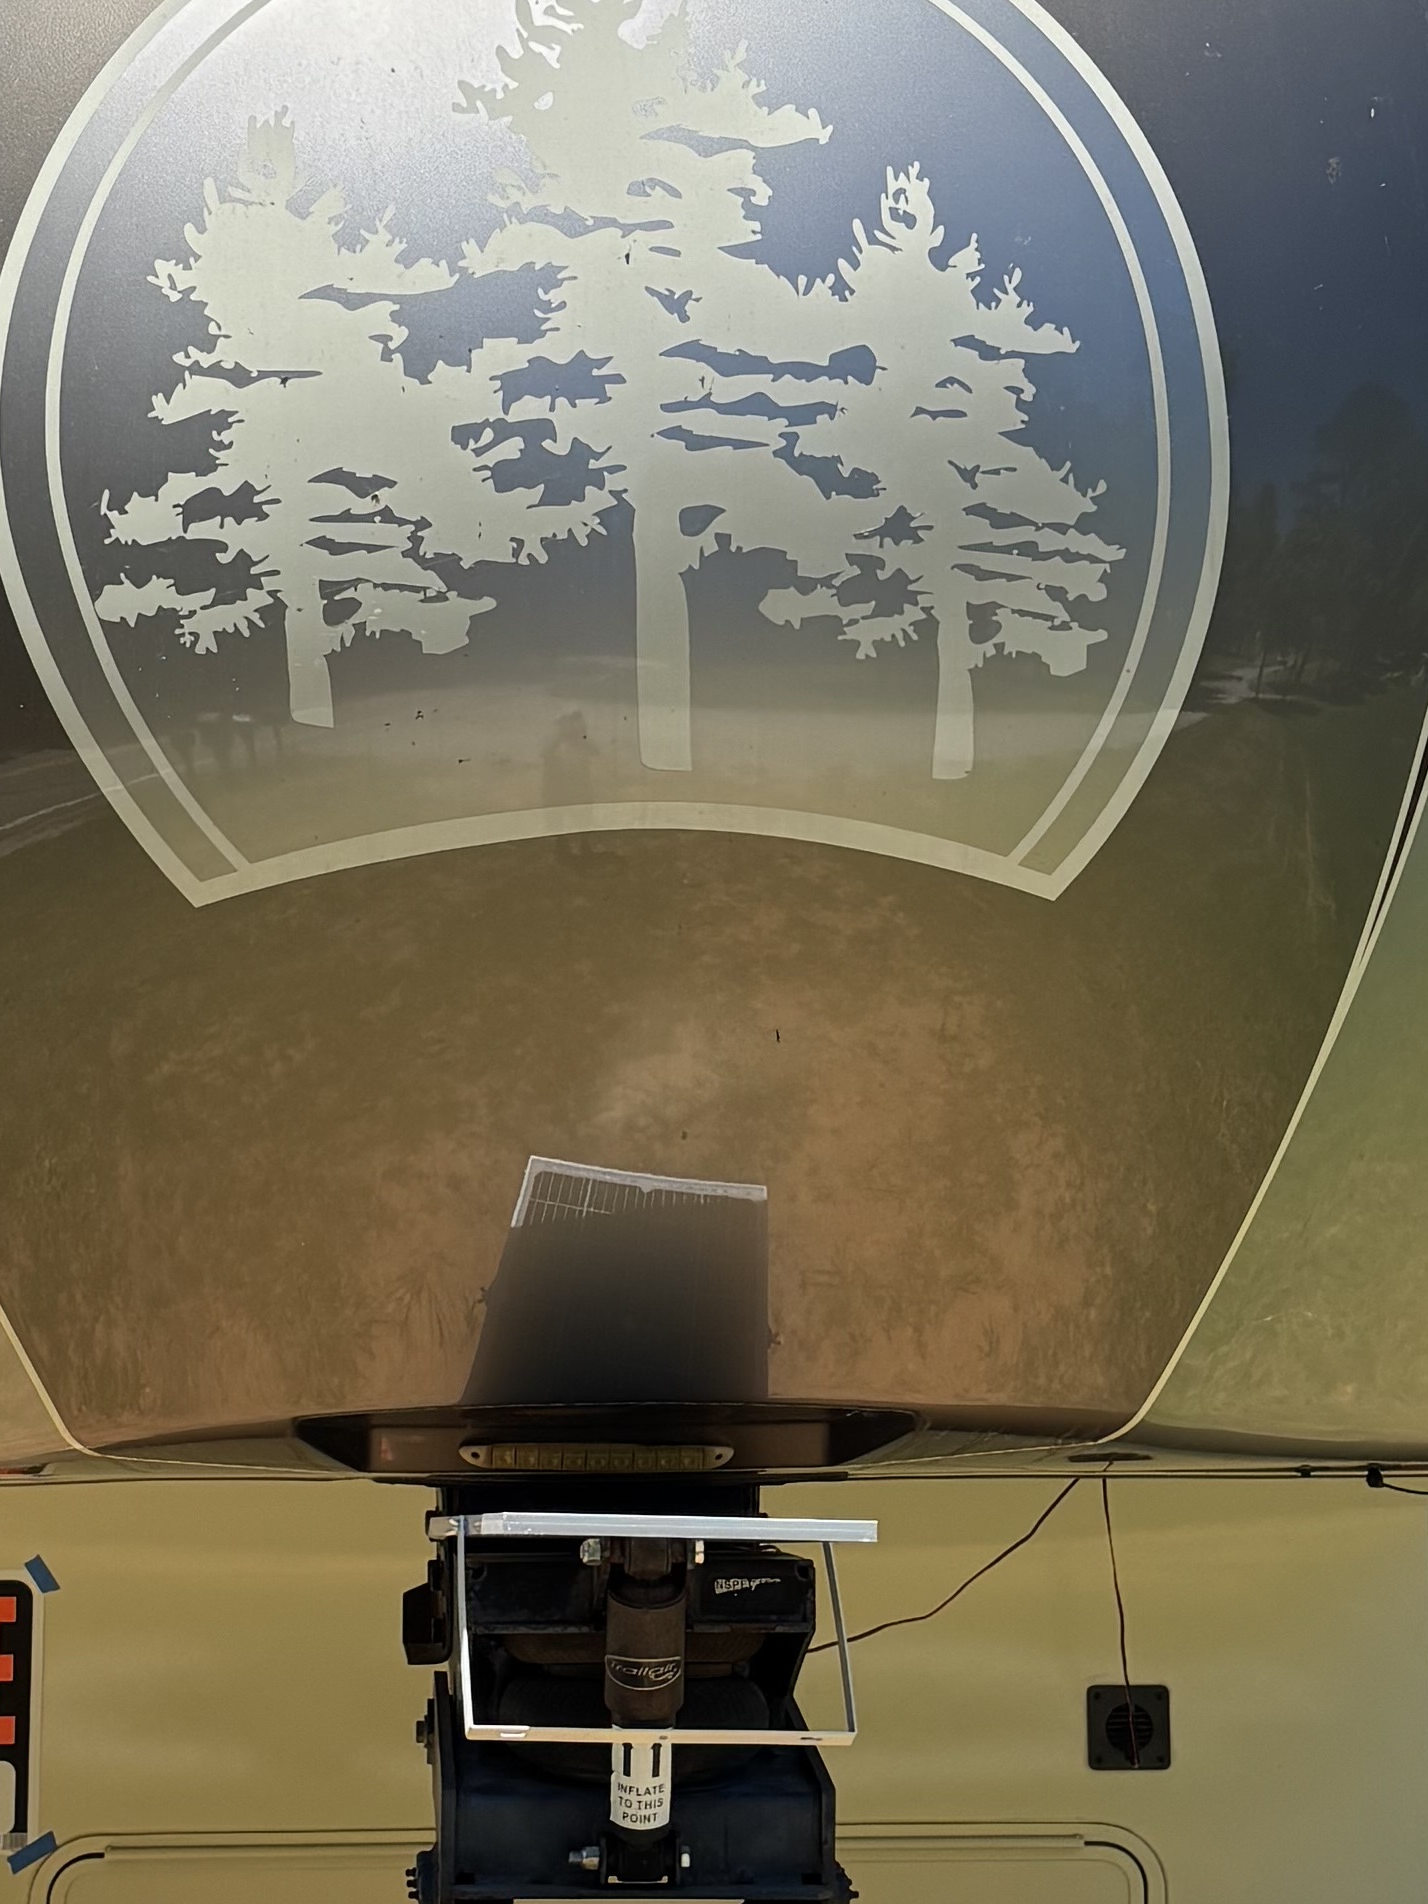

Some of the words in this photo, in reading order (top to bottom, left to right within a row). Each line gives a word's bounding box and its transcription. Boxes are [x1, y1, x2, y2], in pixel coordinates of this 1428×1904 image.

[617, 1782, 665, 1796] INFLATE
[618, 1796, 633, 1808] TO
[636, 1797, 664, 1810] THIS
[622, 1811, 658, 1824] POINT
